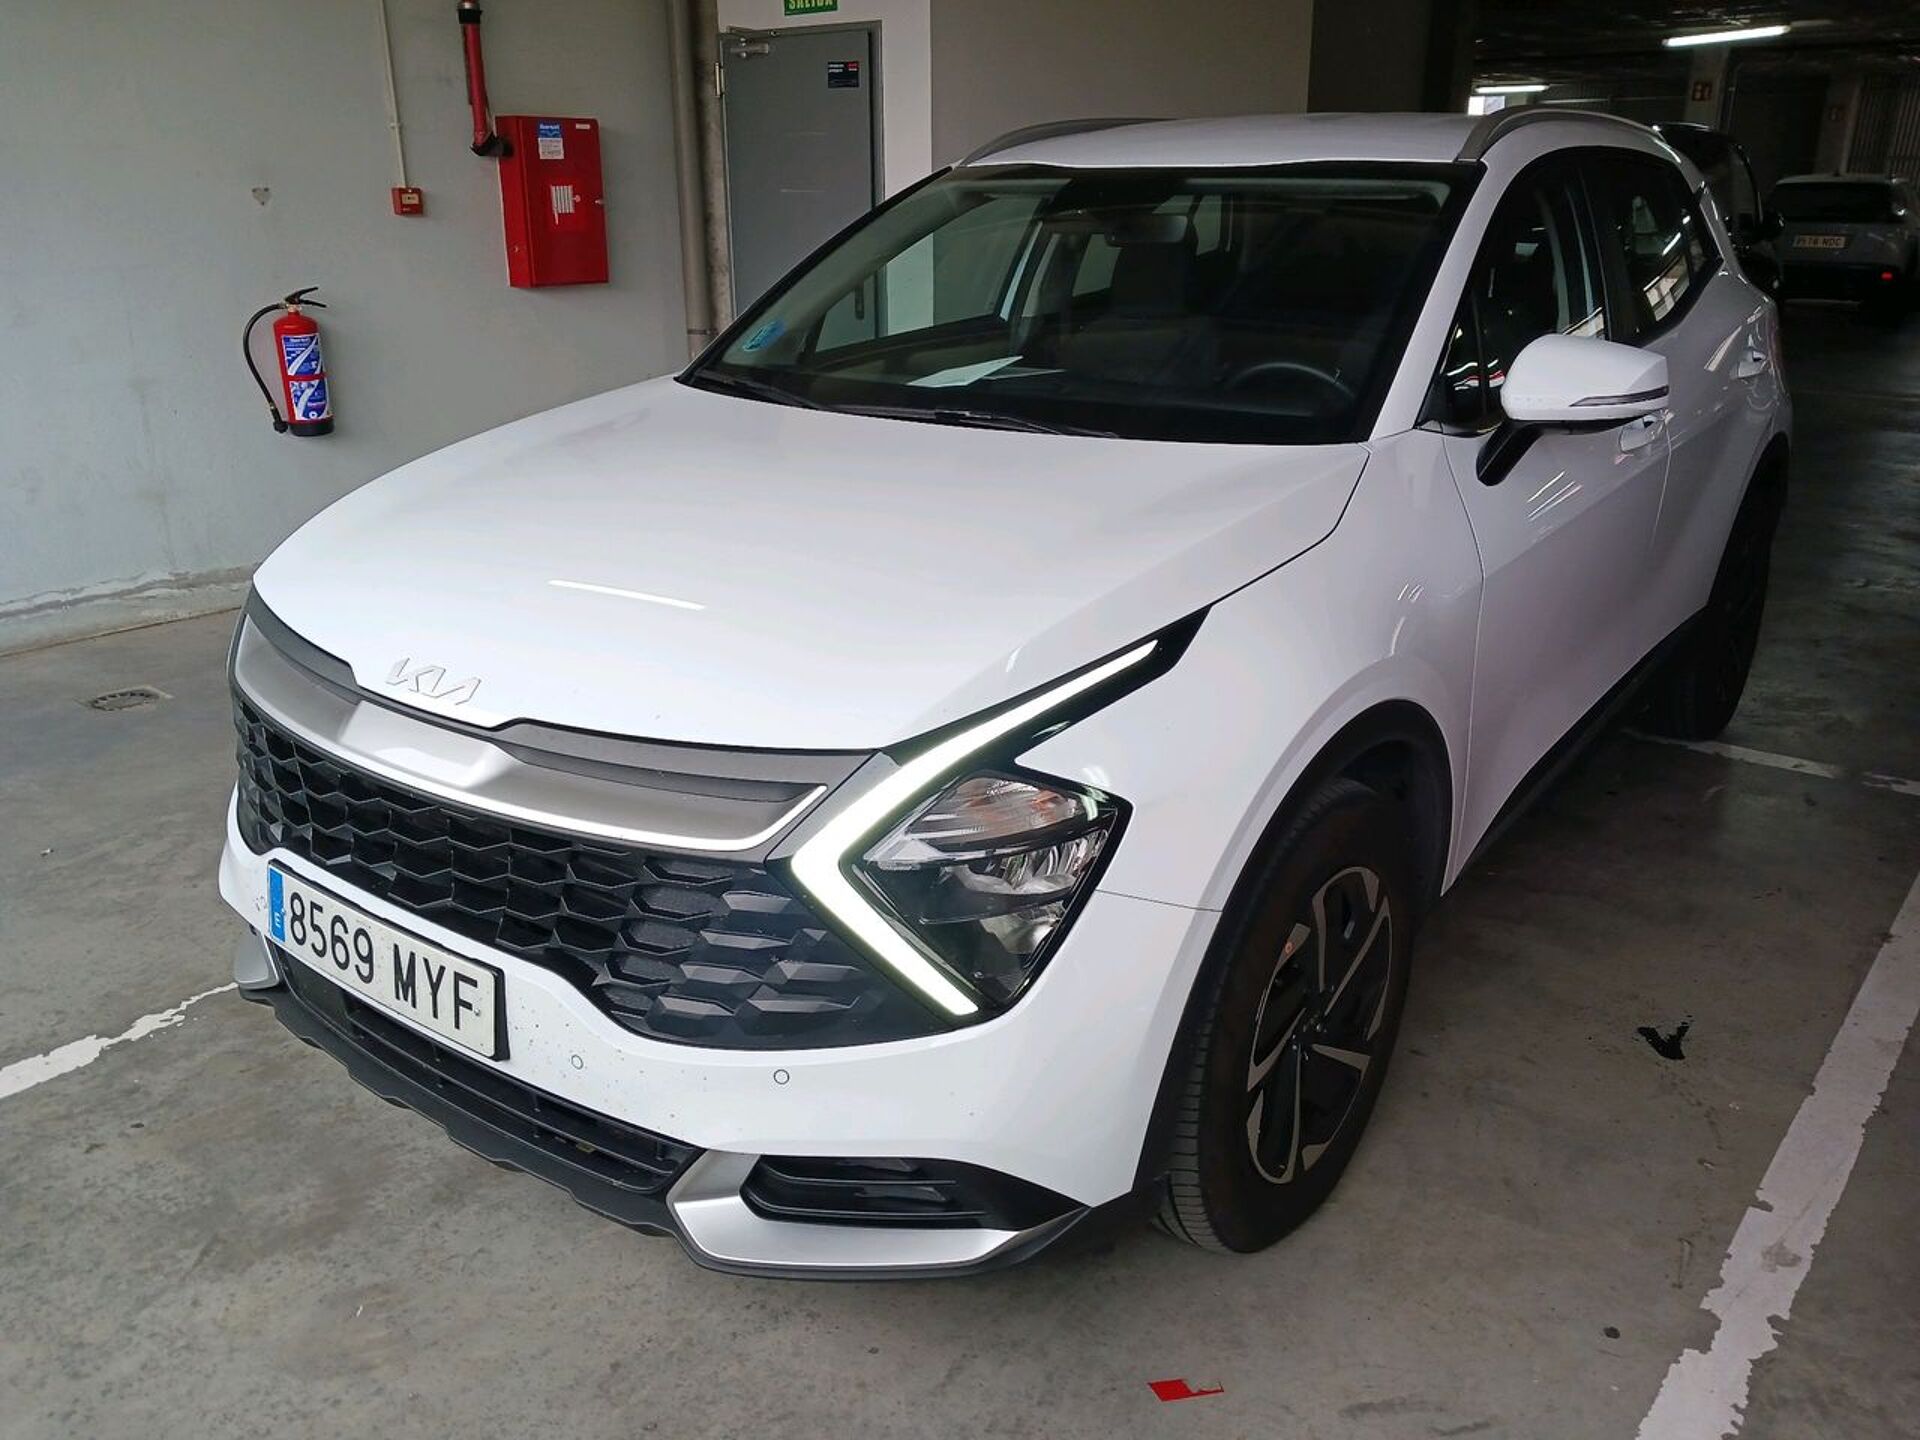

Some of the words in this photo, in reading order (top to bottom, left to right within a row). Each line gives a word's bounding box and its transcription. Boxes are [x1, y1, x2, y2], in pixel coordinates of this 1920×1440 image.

[385, 657, 482, 706] KIA
[290, 891, 375, 985] 8569
[393, 943, 479, 1031] MYF
